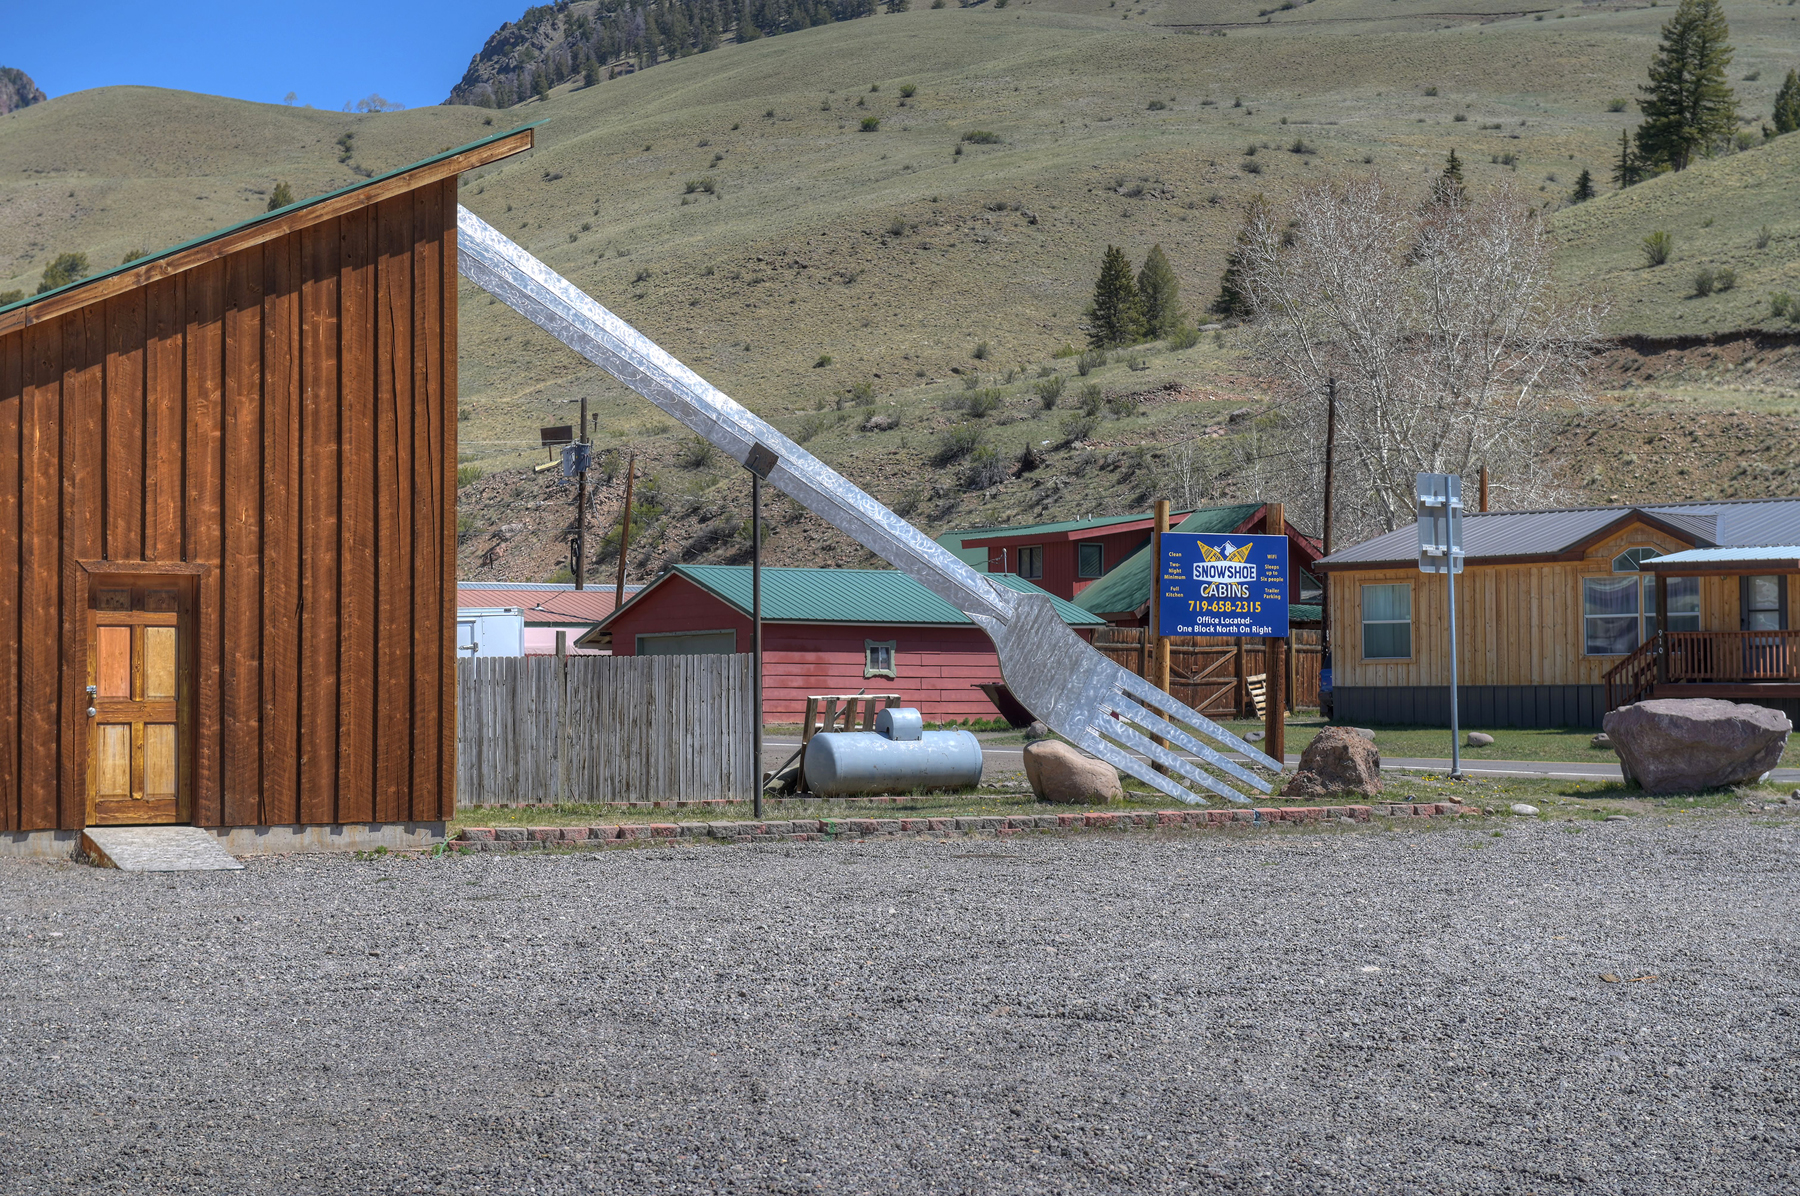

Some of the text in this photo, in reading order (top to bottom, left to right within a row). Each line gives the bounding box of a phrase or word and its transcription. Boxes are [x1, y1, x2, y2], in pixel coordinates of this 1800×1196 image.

[1194, 565, 1256, 579] SNOWSHOE
[1200, 584, 1249, 598] CABINS
[1189, 601, 1261, 612] 719-658-2315
[1252, 626, 1272, 635] Right
